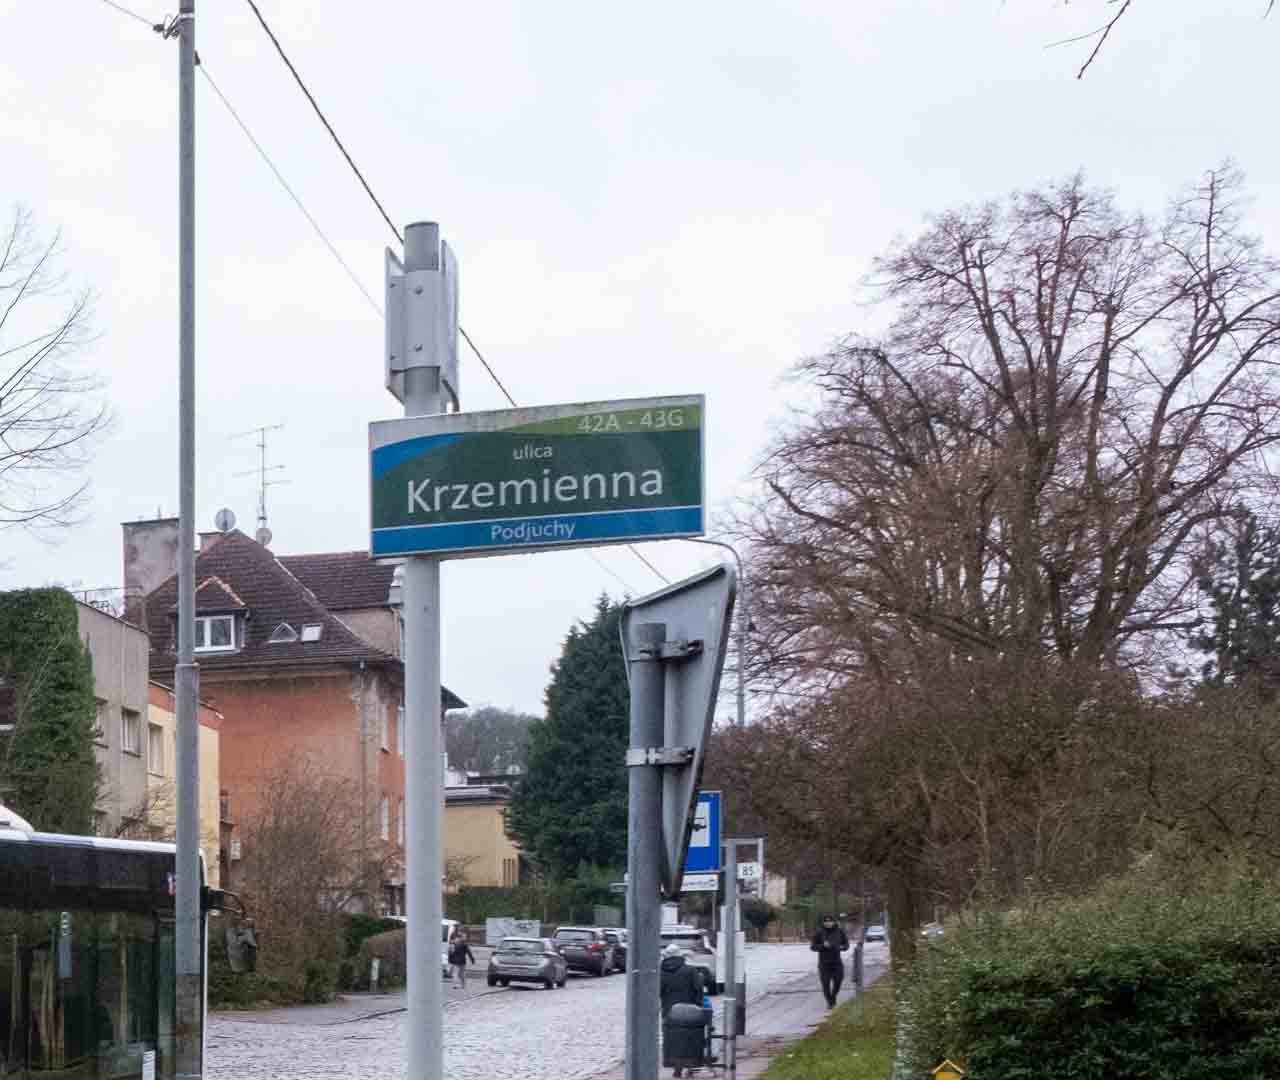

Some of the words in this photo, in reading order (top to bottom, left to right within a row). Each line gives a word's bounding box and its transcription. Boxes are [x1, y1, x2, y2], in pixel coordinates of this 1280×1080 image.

[576, 413, 621, 433] 42A
[639, 409, 684, 428] 43G
[512, 440, 553, 460] ulica
[406, 467, 664, 514] Krzemienna
[490, 520, 576, 543] Podjuchy
